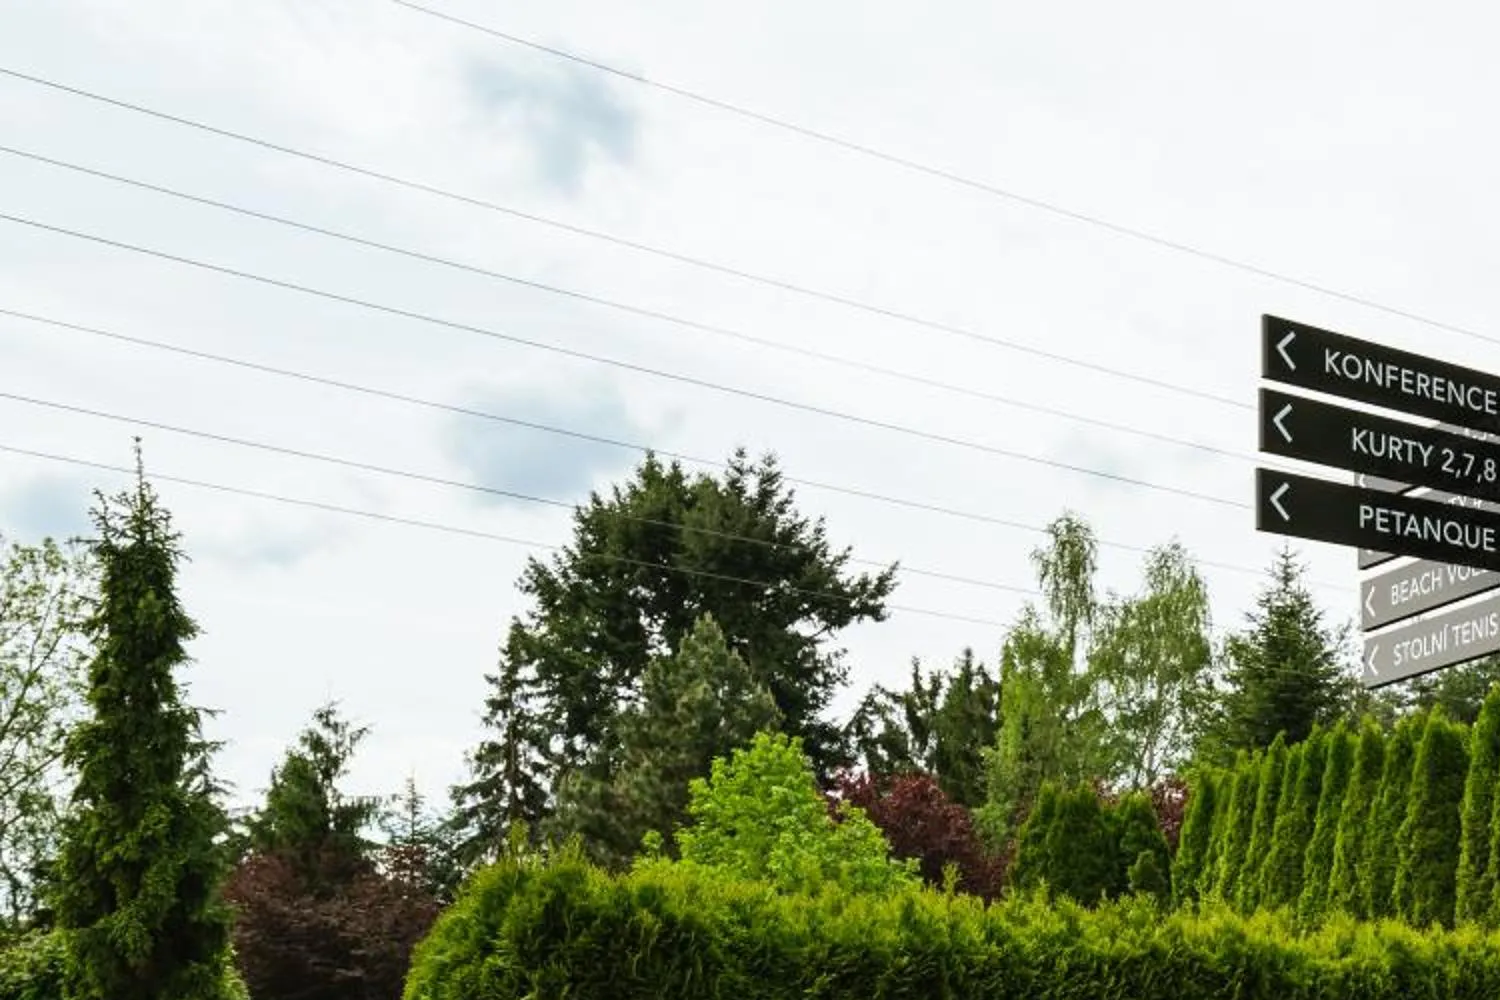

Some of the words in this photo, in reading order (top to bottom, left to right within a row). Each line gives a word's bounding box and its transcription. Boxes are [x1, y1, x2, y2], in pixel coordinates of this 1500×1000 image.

[1325, 348, 1498, 415] KONFERENCE
[1351, 427, 1433, 468] KURTY
[1441, 448, 1497, 483] 2,7,8
[1358, 505, 1496, 551] PETANQUE
[1391, 567, 1443, 606] BEACH
[1393, 623, 1449, 666] STOLNÍ
[1451, 612, 1499, 646] TENIS
